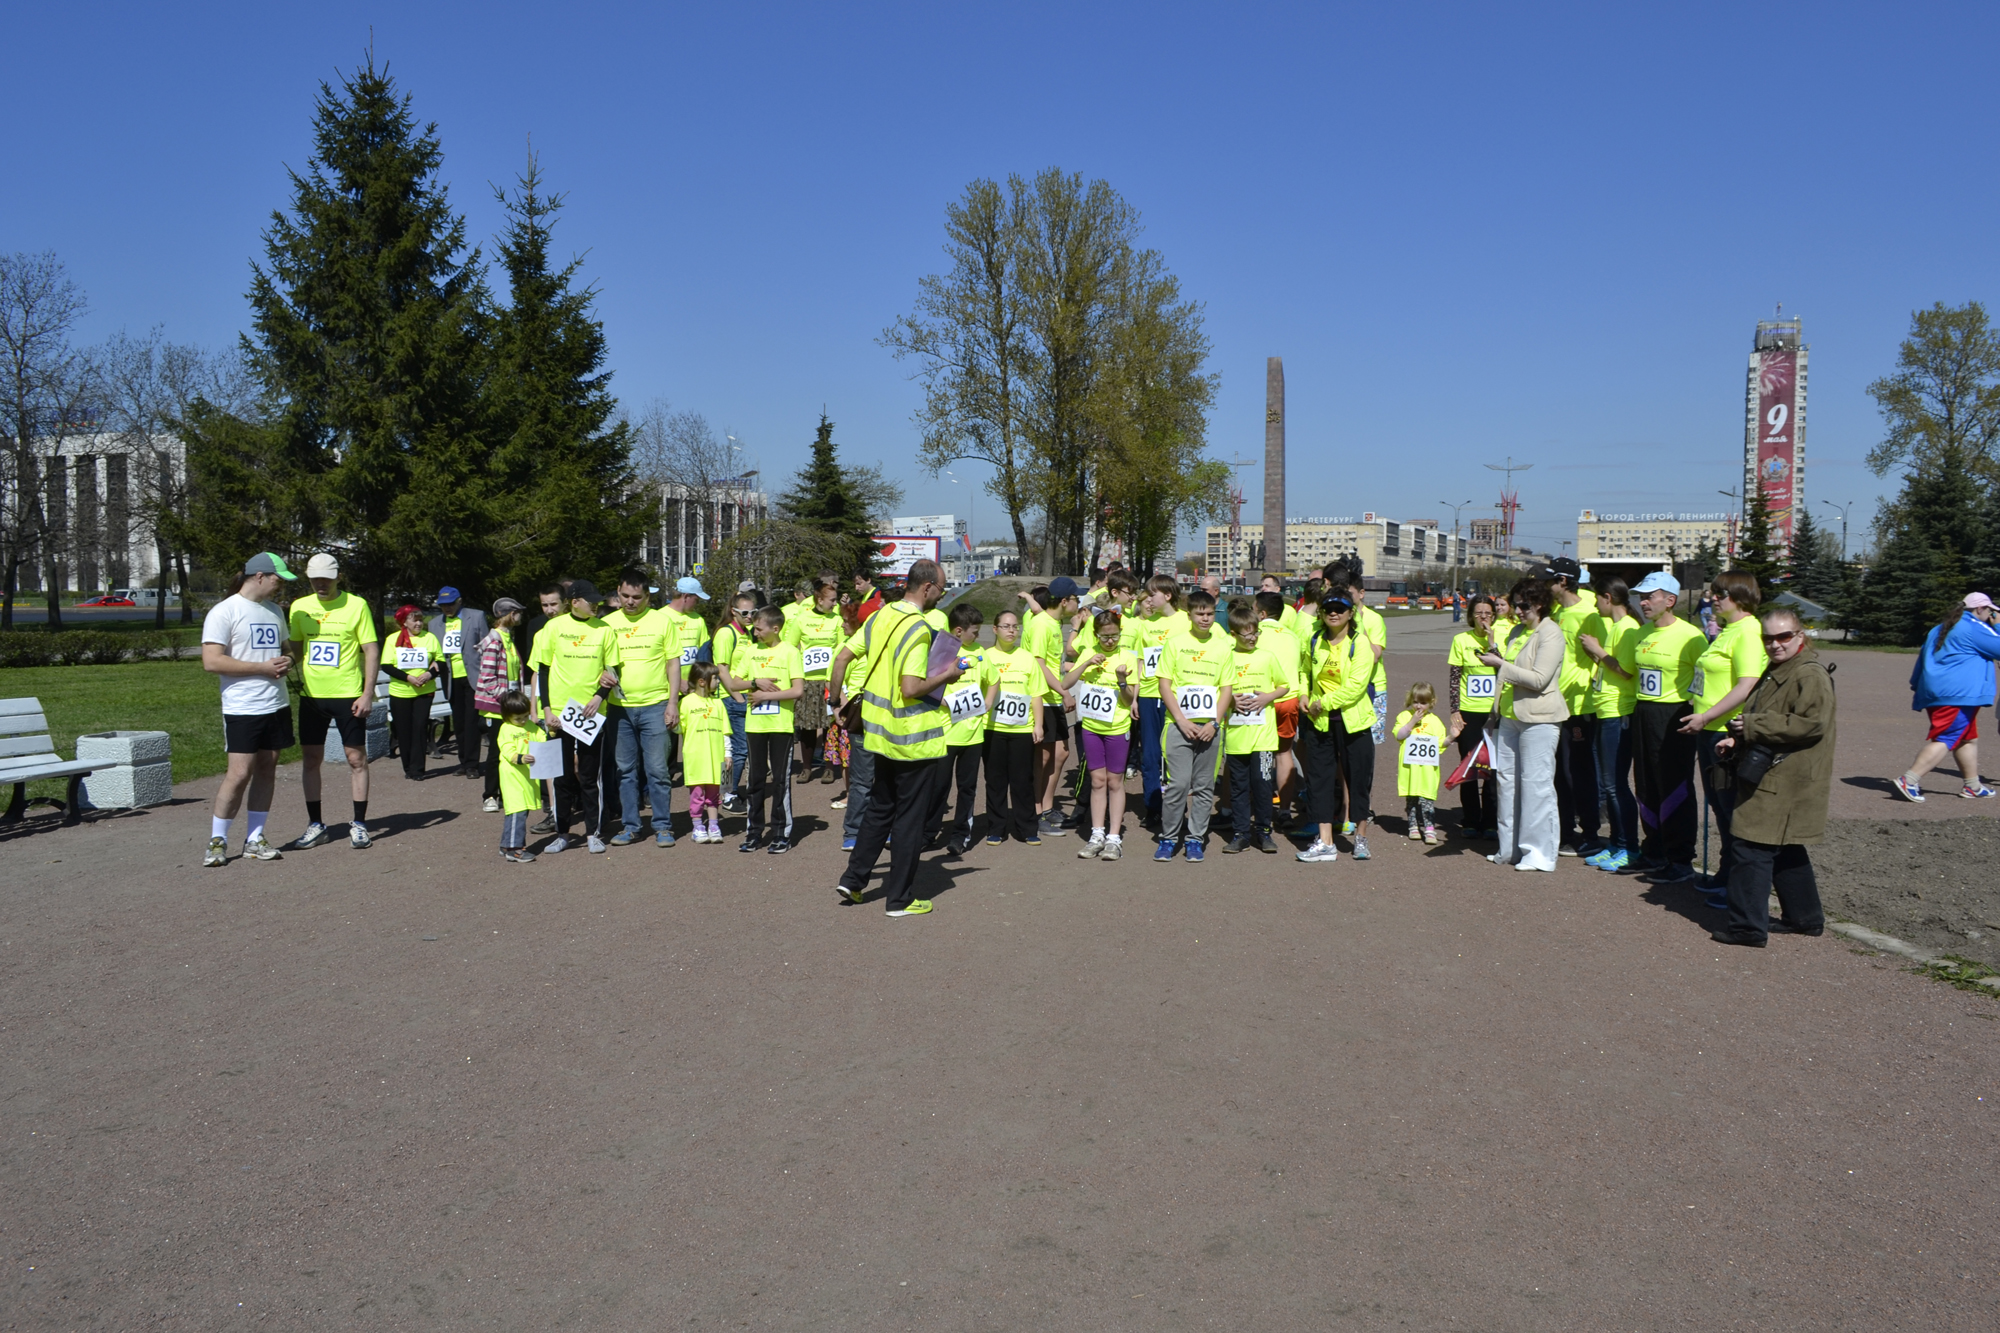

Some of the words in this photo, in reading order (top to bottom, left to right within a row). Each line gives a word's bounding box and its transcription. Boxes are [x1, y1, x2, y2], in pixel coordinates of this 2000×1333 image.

[1767, 403, 1788, 435] 9
[1763, 435, 1788, 443] мая
[1286, 516, 1354, 524] НКТ-ПЕТЕРБУРГ
[1600, 511, 1674, 522] ГОРОД-ГЕРОЙ
[256, 628, 276, 644] 29
[445, 635, 461, 648] 38
[312, 645, 334, 661] 25
[401, 652, 424, 662] 275
[683, 648, 698, 662] 34
[805, 652, 830, 665] 359
[1147, 654, 1162, 668] 4
[1471, 678, 1493, 693] 30
[1640, 672, 1656, 691] 46
[952, 692, 982, 714] 415
[994, 699, 1026, 718] 409
[1081, 693, 1112, 713] 403
[1180, 693, 1213, 710] 400
[562, 706, 597, 736] 382
[1408, 743, 1437, 757] 286
